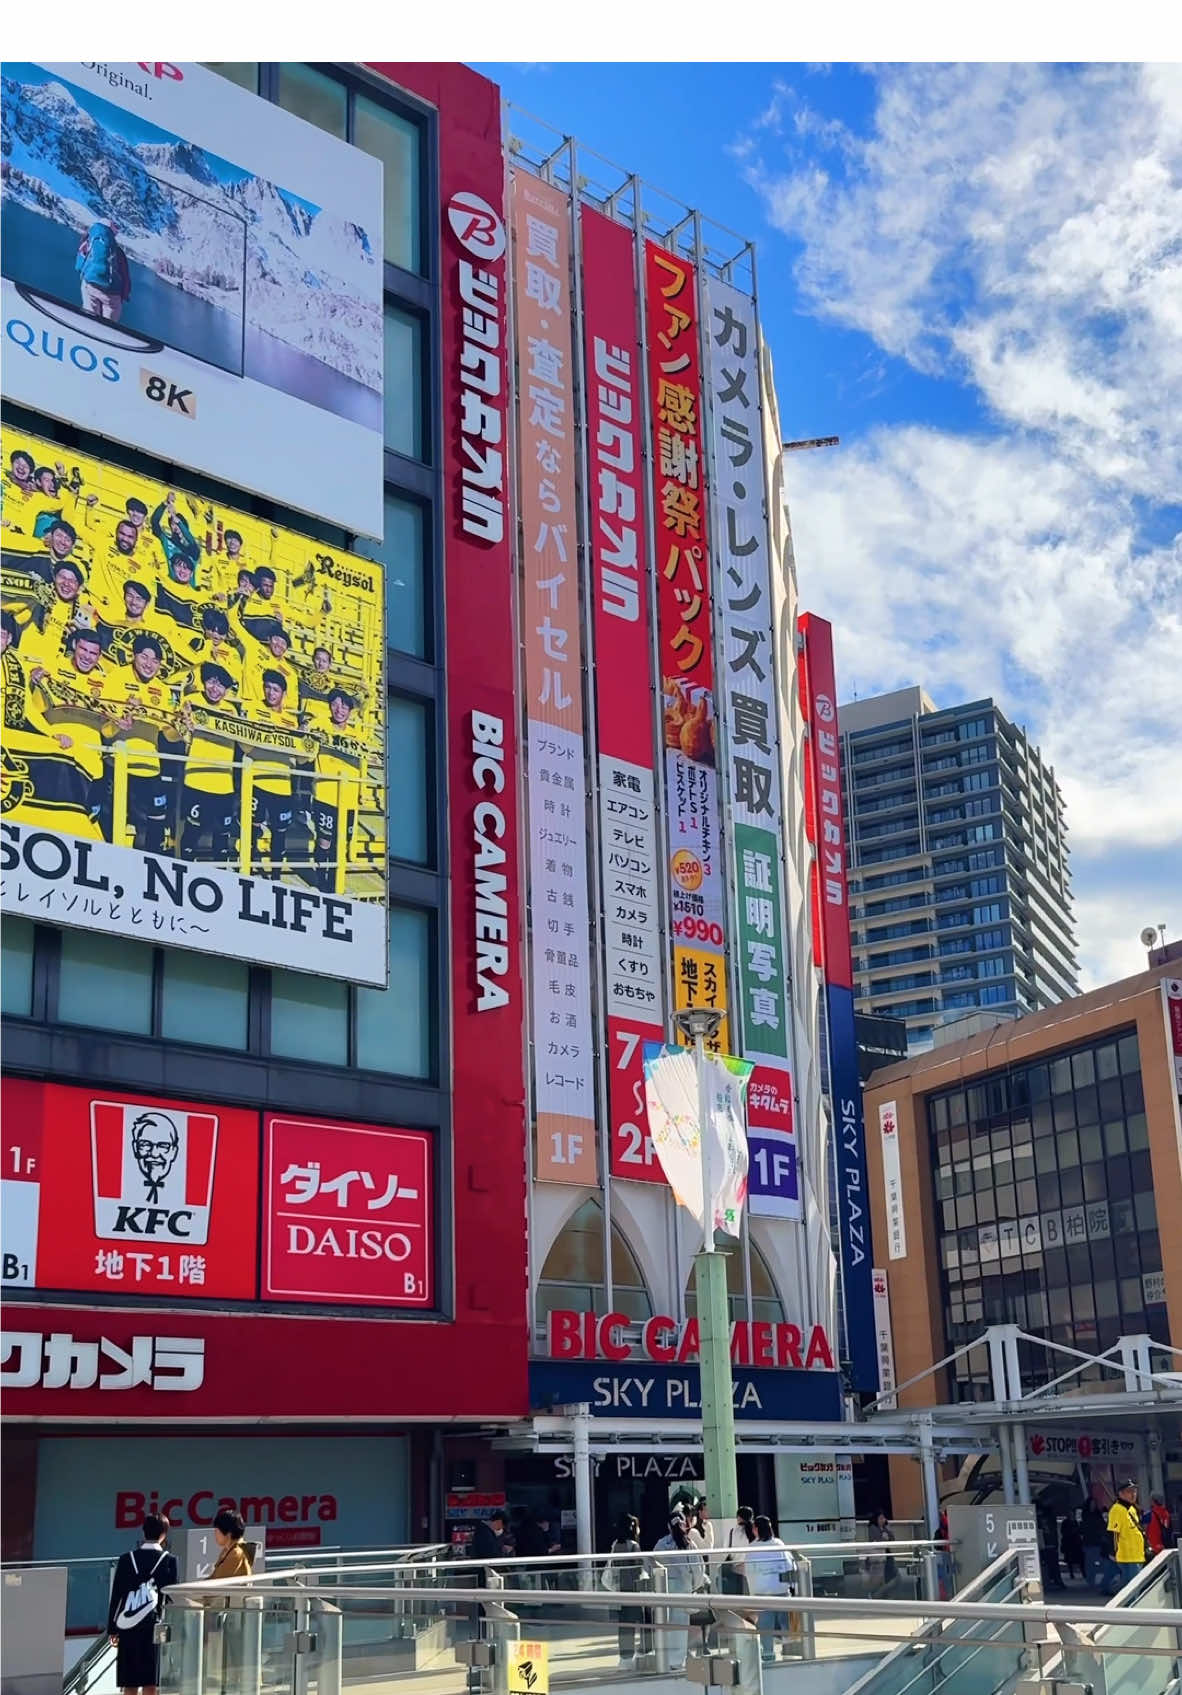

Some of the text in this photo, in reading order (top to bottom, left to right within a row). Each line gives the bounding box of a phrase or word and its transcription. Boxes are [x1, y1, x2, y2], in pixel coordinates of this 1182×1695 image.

[146, 376, 193, 414] 8K
[458, 258, 504, 543] ビックカメラ
[526, 213, 572, 710] 買取・査定ならバイセル
[654, 255, 704, 673] ファン感謝祭パック
[594, 336, 640, 622] ビックカメラ
[316, 553, 375, 593] Reysol
[713, 306, 775, 818] カメラ・レンズ買取
[214, 719, 262, 743] KASHIWA
[537, 738, 575, 760] ブランド
[538, 768, 575, 791] 貴金属
[612, 770, 641, 793] 家電
[318, 813, 334, 830] 38
[607, 800, 649, 820] エアコン
[818, 728, 844, 905] ビックカメラ
[538, 827, 577, 847] ジュエリー
[613, 829, 645, 848] テレビ
[472, 709, 510, 1012] BIC CAMERA
[609, 853, 651, 874] パソコン
[615, 880, 647, 898] スマホ
[238, 878, 353, 943] LIFE
[616, 906, 648, 923] カメラ
[548, 919, 575, 937] 切手
[621, 932, 643, 949] 時計
[673, 916, 723, 945] ¥990
[743, 849, 780, 1030] 証明写真
[618, 958, 648, 975] くすり
[613, 982, 656, 1002] おもちゃ
[548, 1041, 580, 1058] カメラ
[546, 1072, 585, 1091] レコード
[749, 1082, 778, 1096] カメラの
[749, 1094, 789, 1115] キタムラ
[9, 1146, 36, 1174] 1F
[551, 1131, 583, 1165] 1F
[754, 1148, 789, 1186] 1F
[280, 1161, 418, 1211] ダイソー
[841, 1099, 865, 1267] SKY PLAZA
[112, 1206, 193, 1237] KFC
[287, 1225, 412, 1262] DAISO
[3, 1253, 28, 1281] B1
[94, 1249, 206, 1285] 地下1階
[404, 1272, 423, 1294] B1
[549, 1309, 632, 1361] BIC
[593, 1377, 763, 1410] SKY PLA
[616, 1456, 698, 1479] PLAZA
[985, 1513, 995, 1533] 5
[199, 1536, 207, 1554] 1
